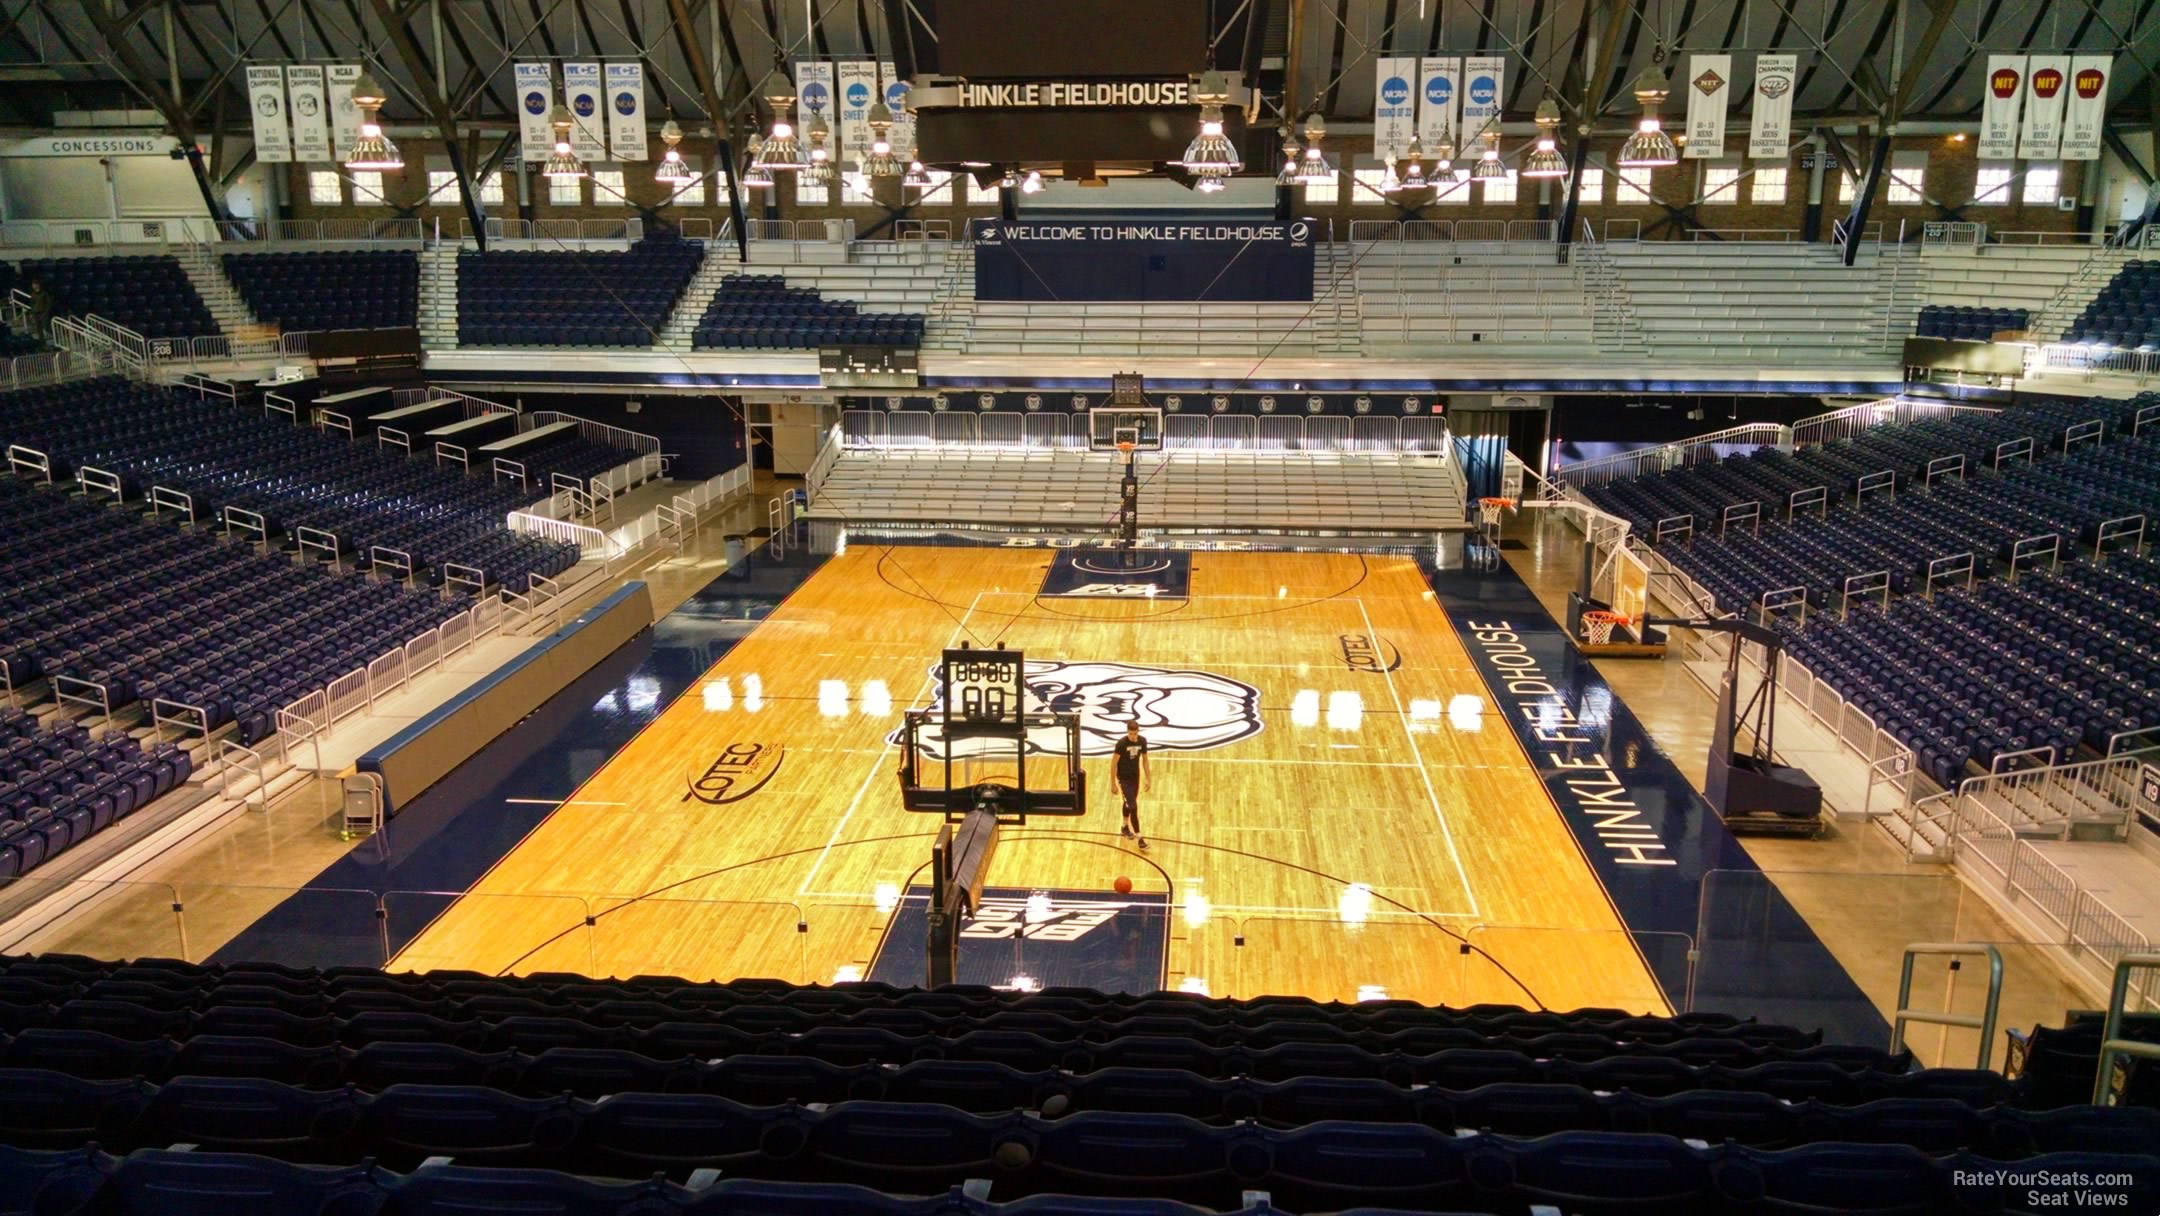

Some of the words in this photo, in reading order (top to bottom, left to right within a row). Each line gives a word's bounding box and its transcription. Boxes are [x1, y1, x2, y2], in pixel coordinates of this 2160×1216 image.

[248, 68, 280, 78] NATIONAL
[289, 68, 321, 78] NATIONAL
[334, 68, 354, 76] NCAA
[1758, 66, 1794, 74] CHAMPIONS
[249, 80, 280, 88] CHAMPIONS
[290, 80, 321, 88] CHAMPIONS
[567, 80, 599, 88] CHAMPIONS
[608, 80, 641, 89] CHAMPIONS
[1700, 79, 1718, 87] NIT
[1995, 77, 2014, 89] NIT
[2036, 77, 2057, 89] NIT
[2079, 77, 2100, 89] NIT
[958, 84, 1039, 106] HINKLE
[1050, 82, 1188, 106] FIELDHOUSE
[1384, 89, 1409, 98] NCAA
[1428, 89, 1452, 98] NCAA
[843, 110, 864, 120] SWEET
[52, 140, 154, 152] CONCESSIONS
[1004, 226, 1086, 240] WELCOME
[1090, 227, 1113, 240] TO
[1117, 227, 1176, 240] HINKLE
[1180, 227, 1284, 240] FIELDHOUSE
[153, 345, 171, 355] 208
[1468, 620, 1591, 742] FIELDHOUSE
[2144, 781, 2158, 802] 119
[1550, 753, 1678, 865] HINKLE
